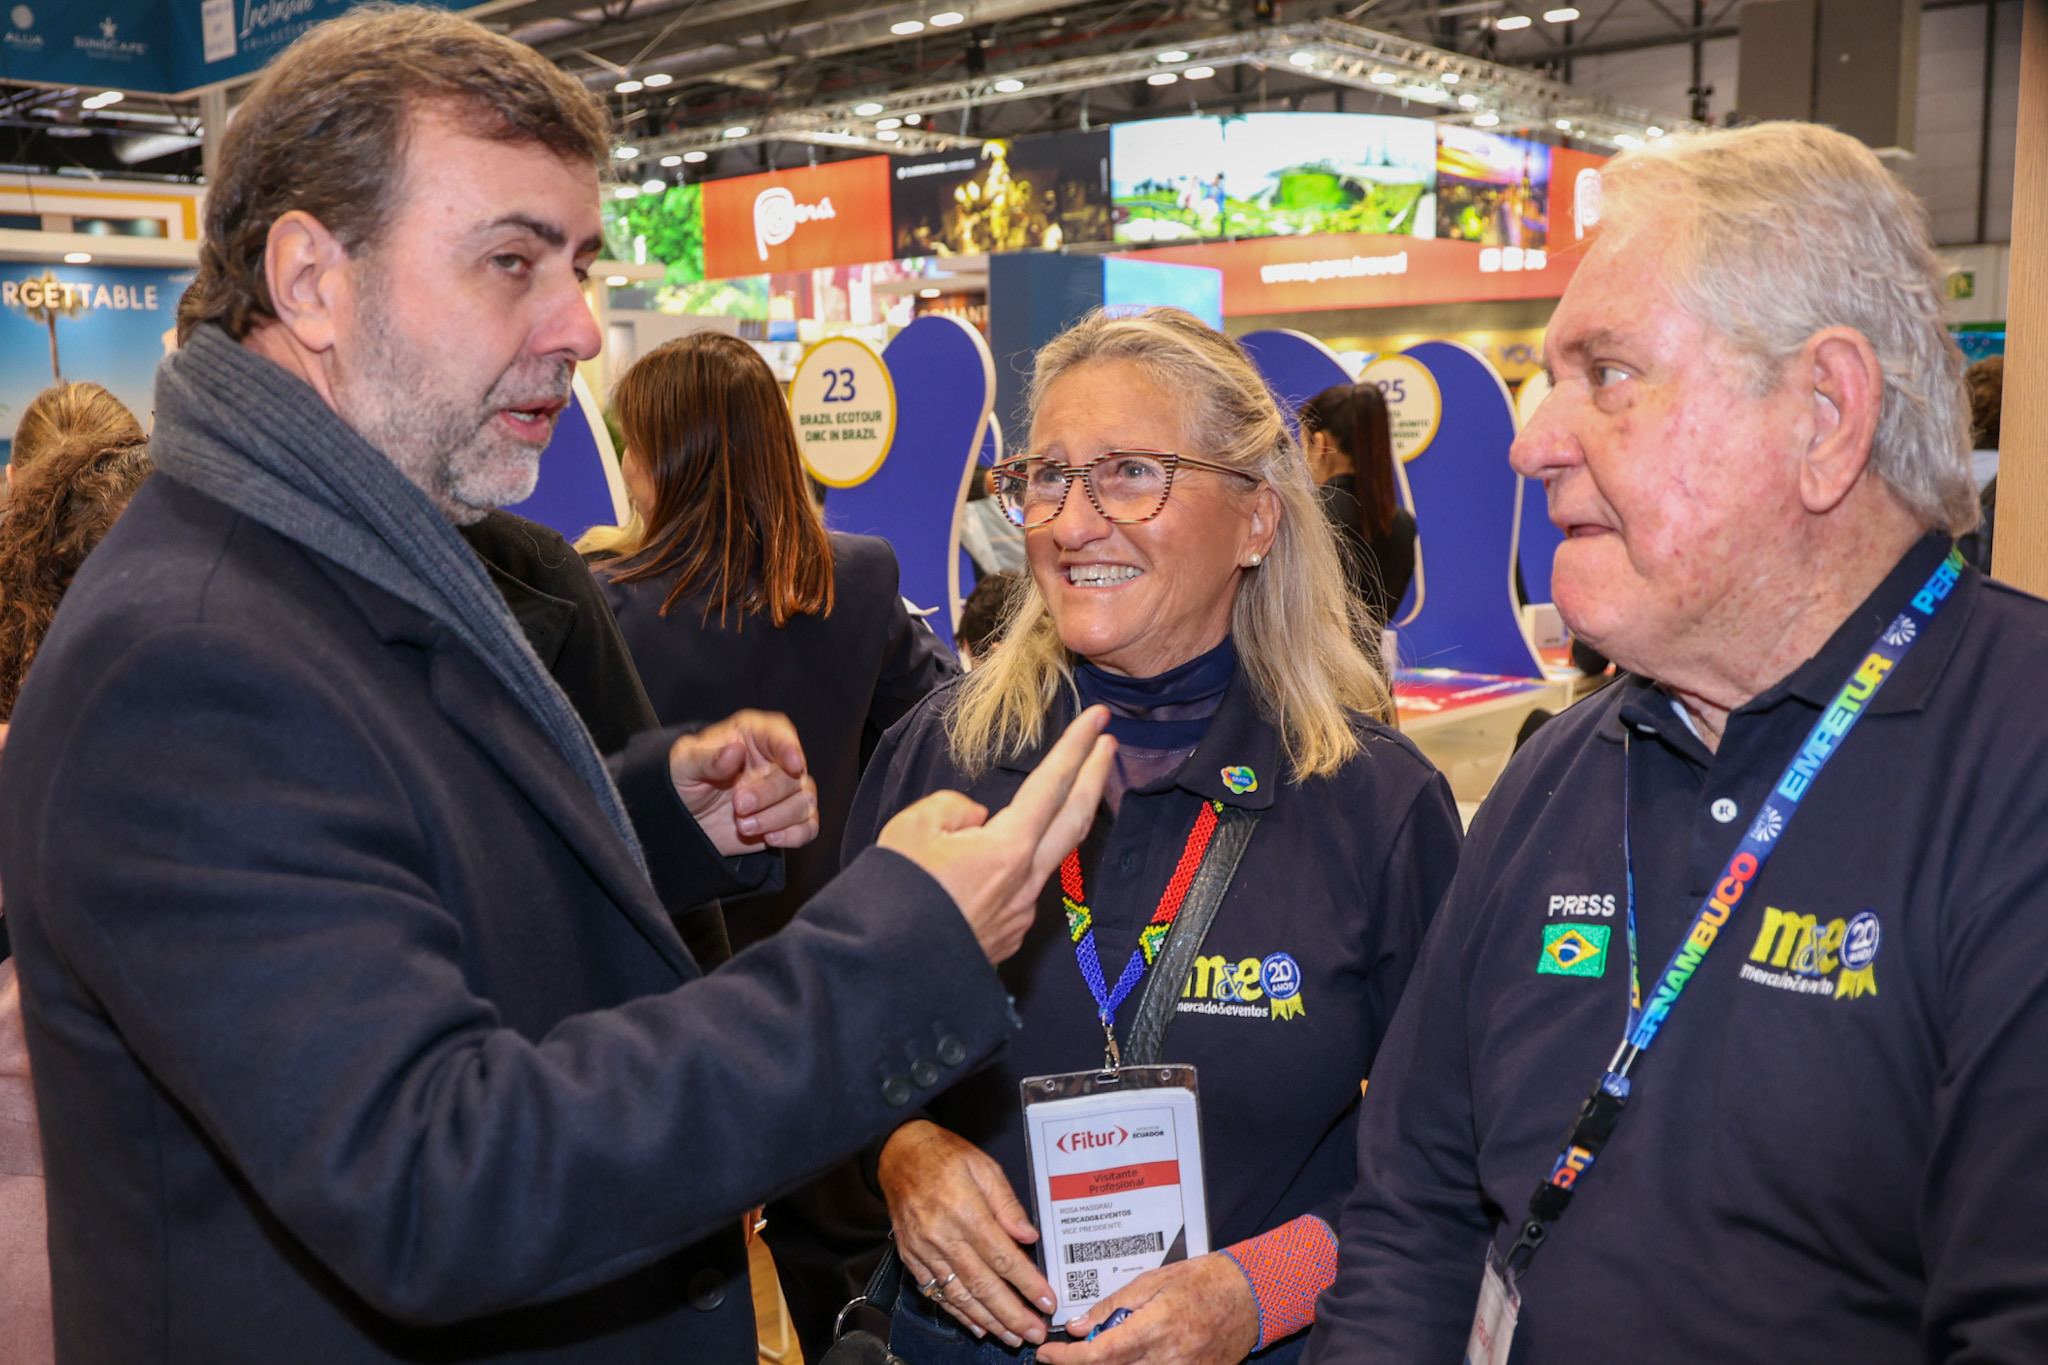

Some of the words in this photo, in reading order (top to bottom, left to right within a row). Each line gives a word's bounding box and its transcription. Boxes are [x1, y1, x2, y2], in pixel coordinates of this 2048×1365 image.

[2, 280, 159, 310] RGETTABLE
[822, 368, 857, 403] 23
[1378, 379, 1407, 403] 25
[800, 413, 832, 425] BRAZIL
[836, 411, 882, 424] ECOTOUR
[805, 430, 827, 442] DMC
[829, 430, 839, 441] IN
[842, 429, 877, 440] BRAZIL
[1910, 545, 1963, 615] PERN
[1777, 652, 1893, 802] EMPETUR
[1548, 894, 1616, 917] PRESS
[1850, 919, 1876, 951] 20
[1629, 852, 1759, 1050] ERNAMBUCO
[1268, 960, 1292, 983] 20
[1272, 981, 1294, 993] ANOS
[1071, 1130, 1115, 1151] Fitur
[1132, 1130, 1164, 1139] ECUADOR
[1089, 1177, 1145, 1195] Profesional
[1093, 1168, 1138, 1183] Visitante
[1060, 1204, 1079, 1214] ROSA
[1080, 1202, 1113, 1212] MASGRAU
[1061, 1209, 1132, 1225] MERCADO&EVENTOS
[1061, 1226, 1078, 1235] VICE
[1079, 1221, 1122, 1233] PRESIDENTE
